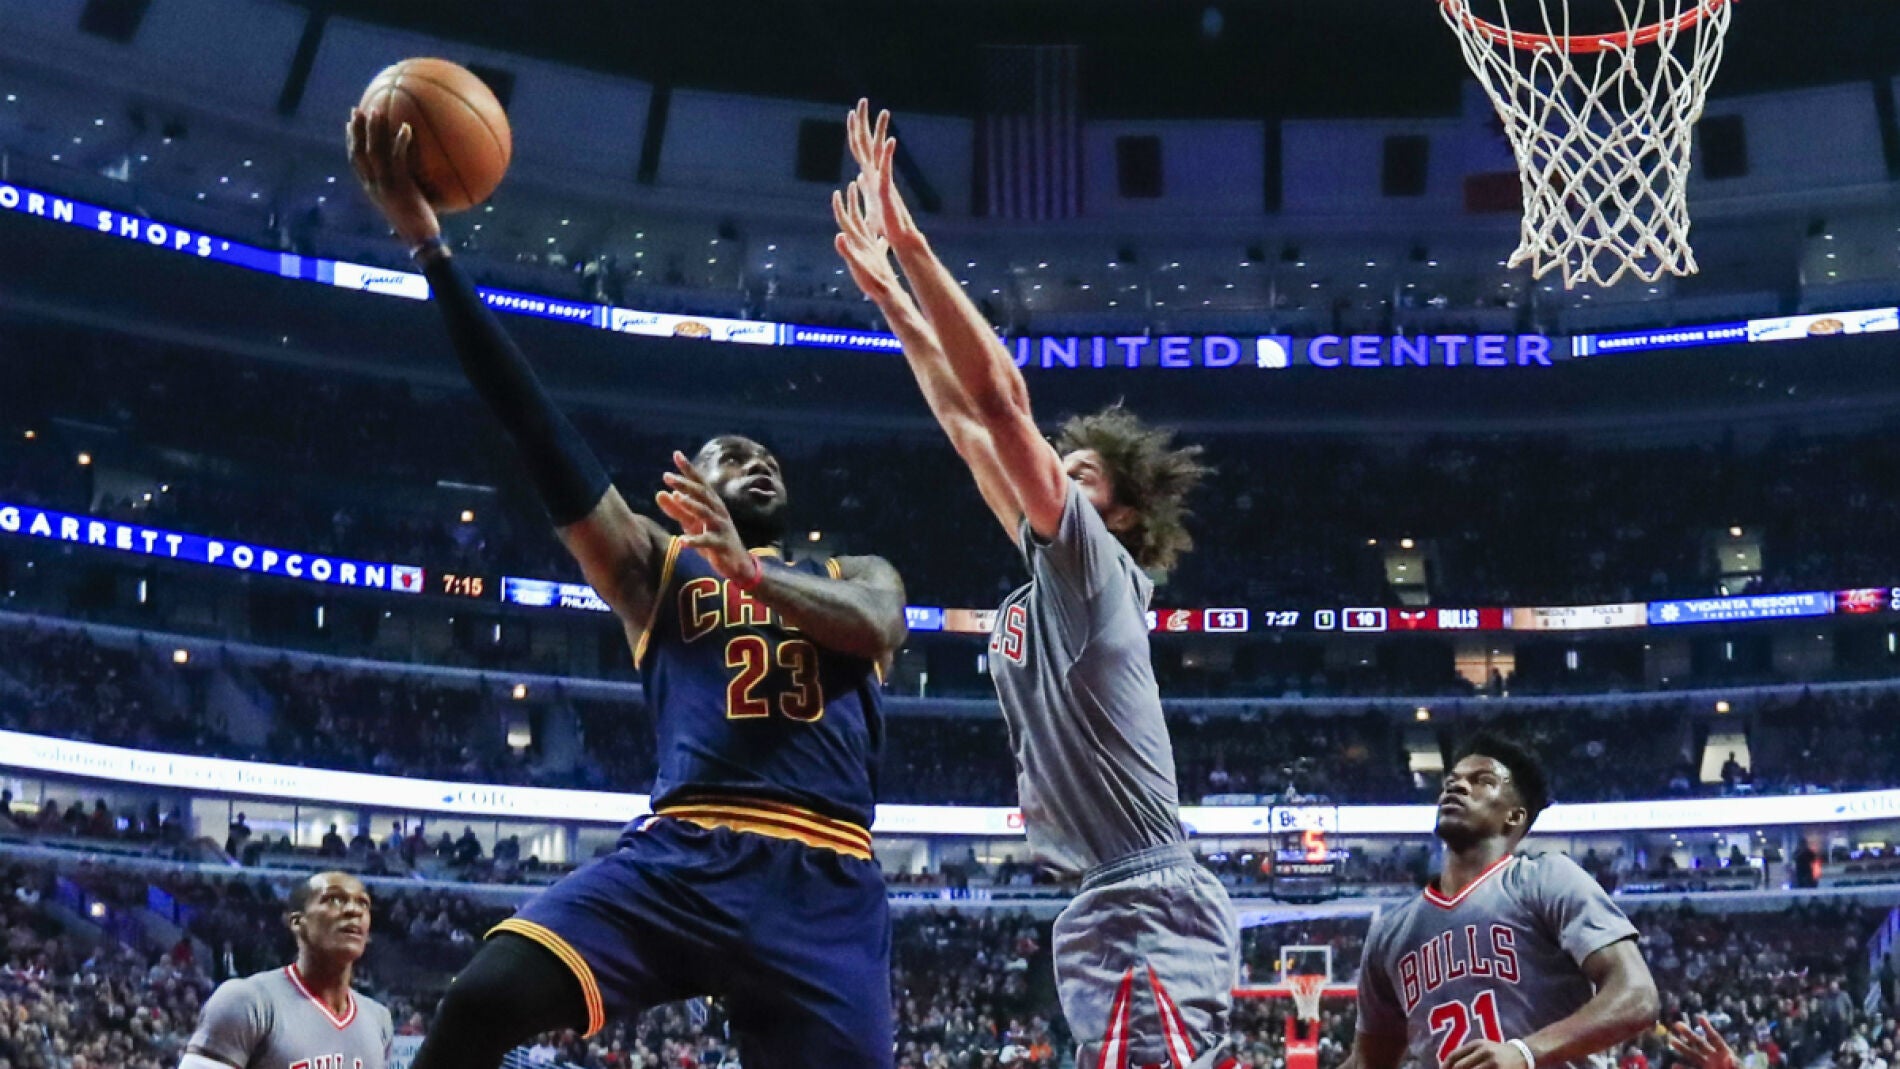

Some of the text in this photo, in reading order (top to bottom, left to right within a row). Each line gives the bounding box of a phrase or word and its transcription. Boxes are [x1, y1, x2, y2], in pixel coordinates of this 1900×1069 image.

[0, 184, 73, 223] ORN
[487, 293, 546, 313] POPCORN
[796, 330, 847, 345] GARRETT
[1649, 331, 1705, 345] POPCORN
[1307, 334, 1553, 369] CENTER
[0, 506, 385, 588] GARRETT POPCORN
[443, 574, 483, 597] 7:15
[1592, 605, 1624, 615] FOULS
[1685, 594, 1814, 613] VIDANTA RESORTS
[1217, 611, 1237, 627] 13
[1264, 610, 1300, 626] 7:27
[1355, 611, 1375, 627] 10
[1437, 608, 1480, 629] BULLS
[724, 634, 824, 723] 23
[1302, 829, 1328, 864] 5
[1399, 924, 1521, 1018] BULLS
[1427, 988, 1505, 1069] 21
